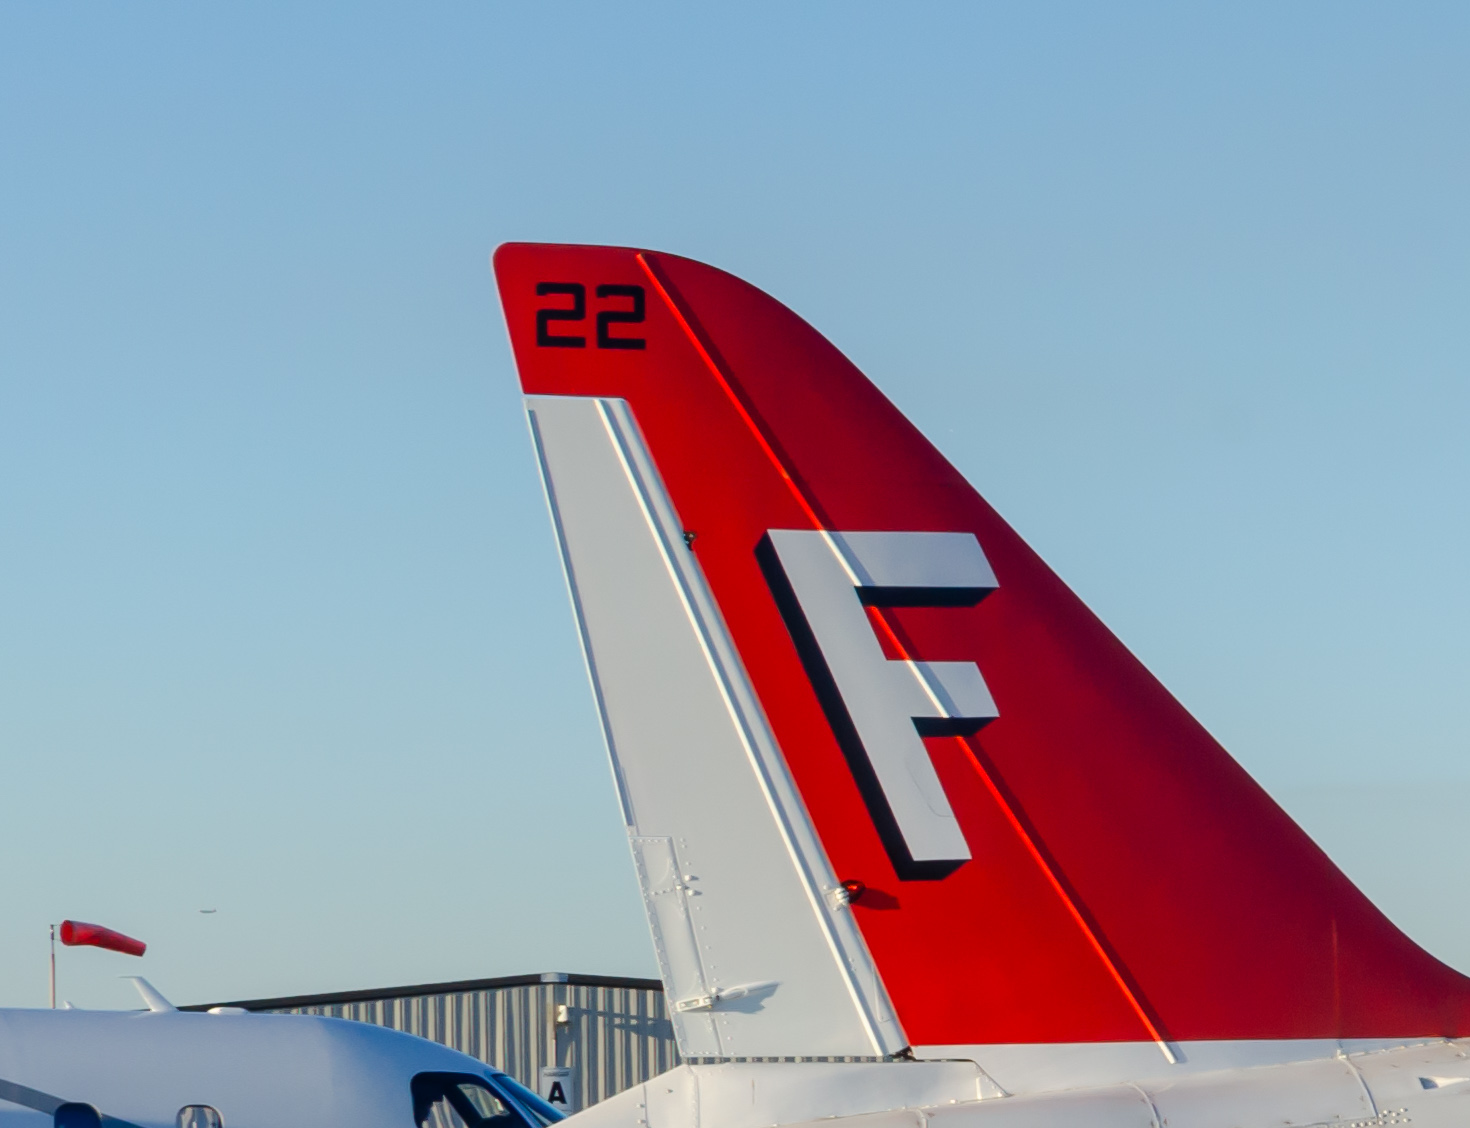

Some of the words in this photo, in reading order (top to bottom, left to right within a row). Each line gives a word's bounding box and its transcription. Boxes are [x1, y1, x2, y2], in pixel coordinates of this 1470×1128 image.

[536, 281, 646, 351] 22
[755, 528, 999, 881] F
[547, 1081, 568, 1105] A
